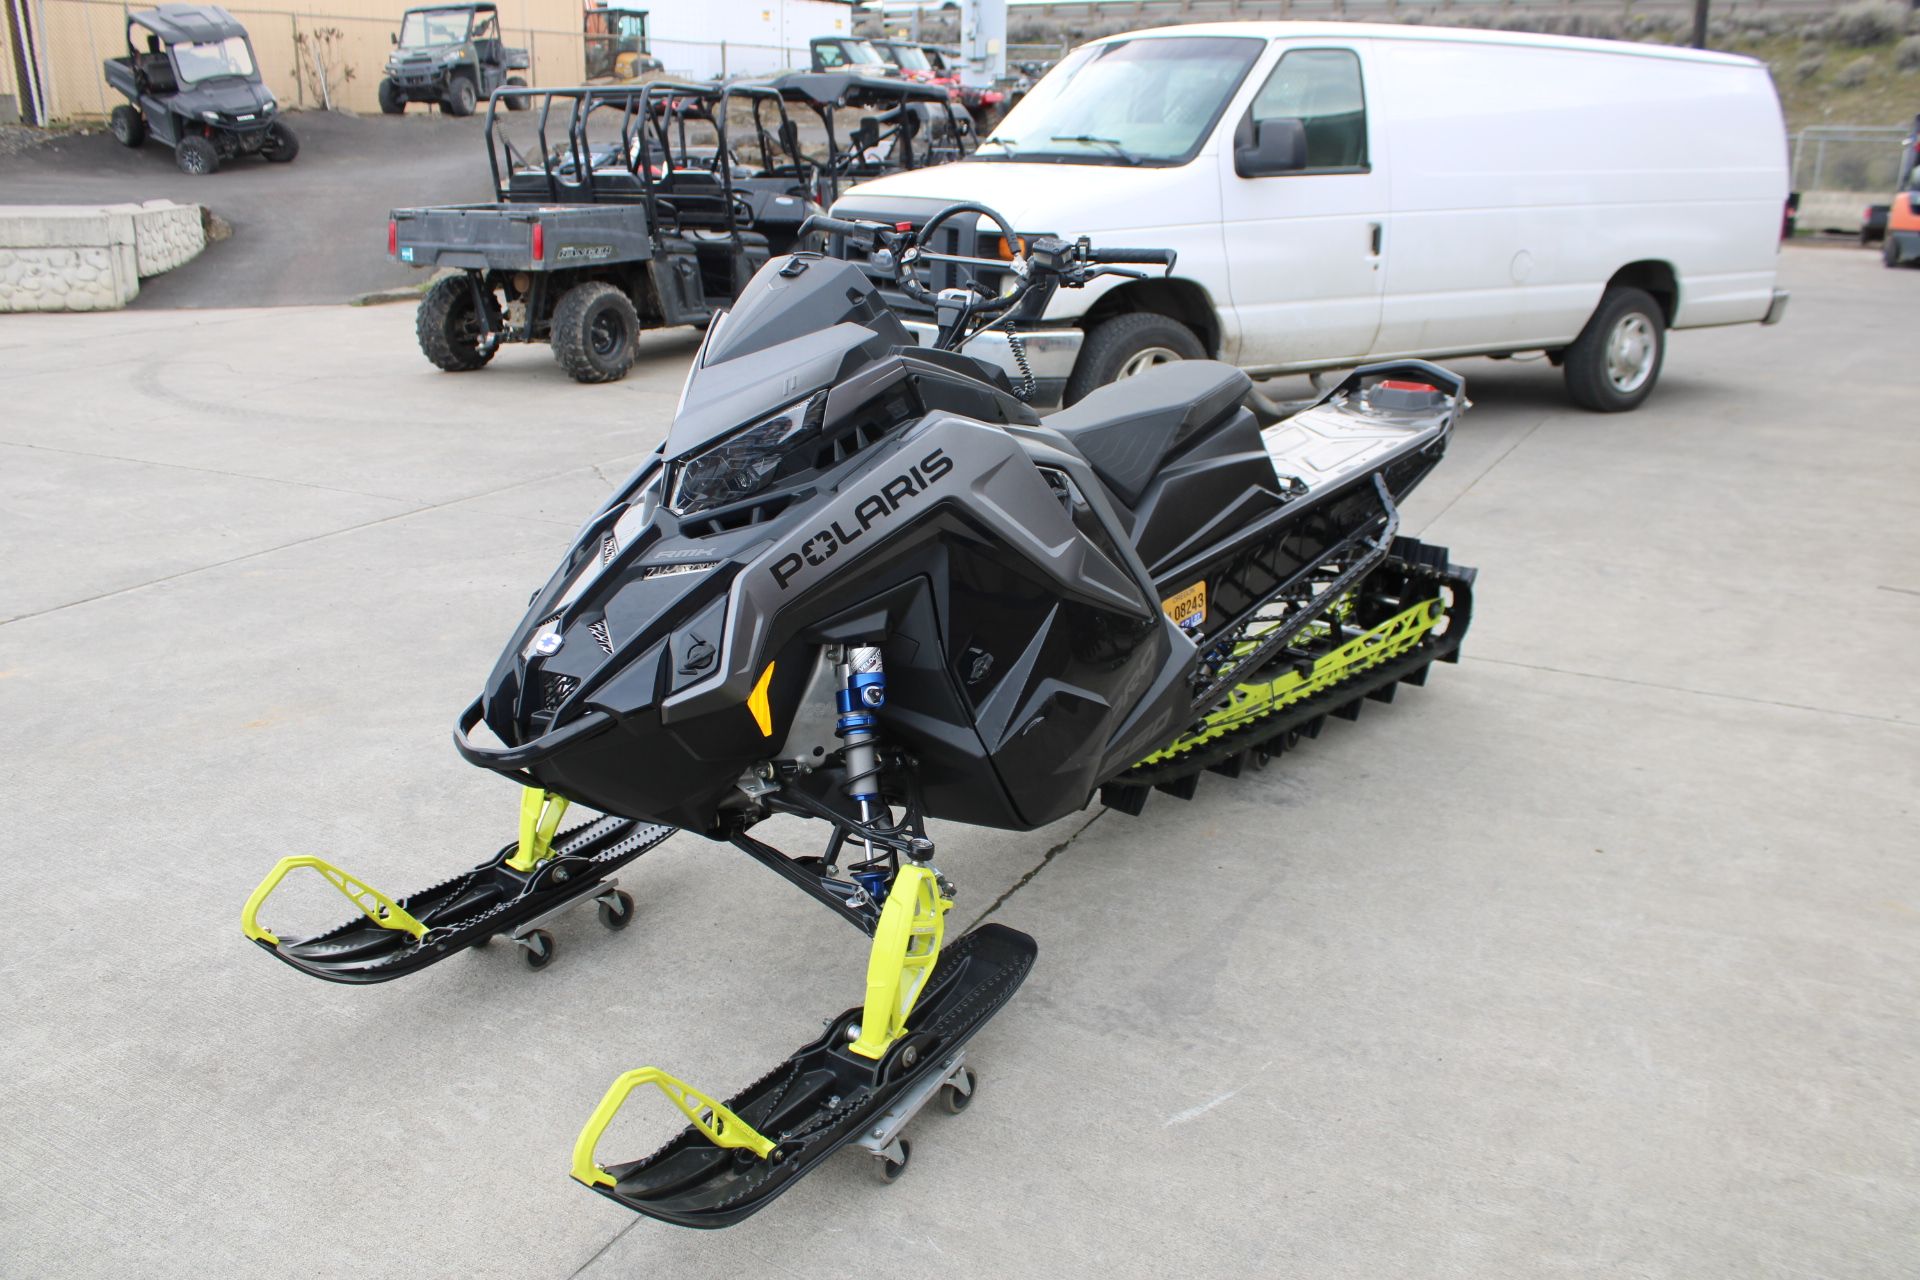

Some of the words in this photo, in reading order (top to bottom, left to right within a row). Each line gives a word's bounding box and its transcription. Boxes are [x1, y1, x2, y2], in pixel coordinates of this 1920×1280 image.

[769, 447, 954, 591] POLARIS
[654, 547, 718, 560] RMK
[1174, 592, 1204, 621] 08243
